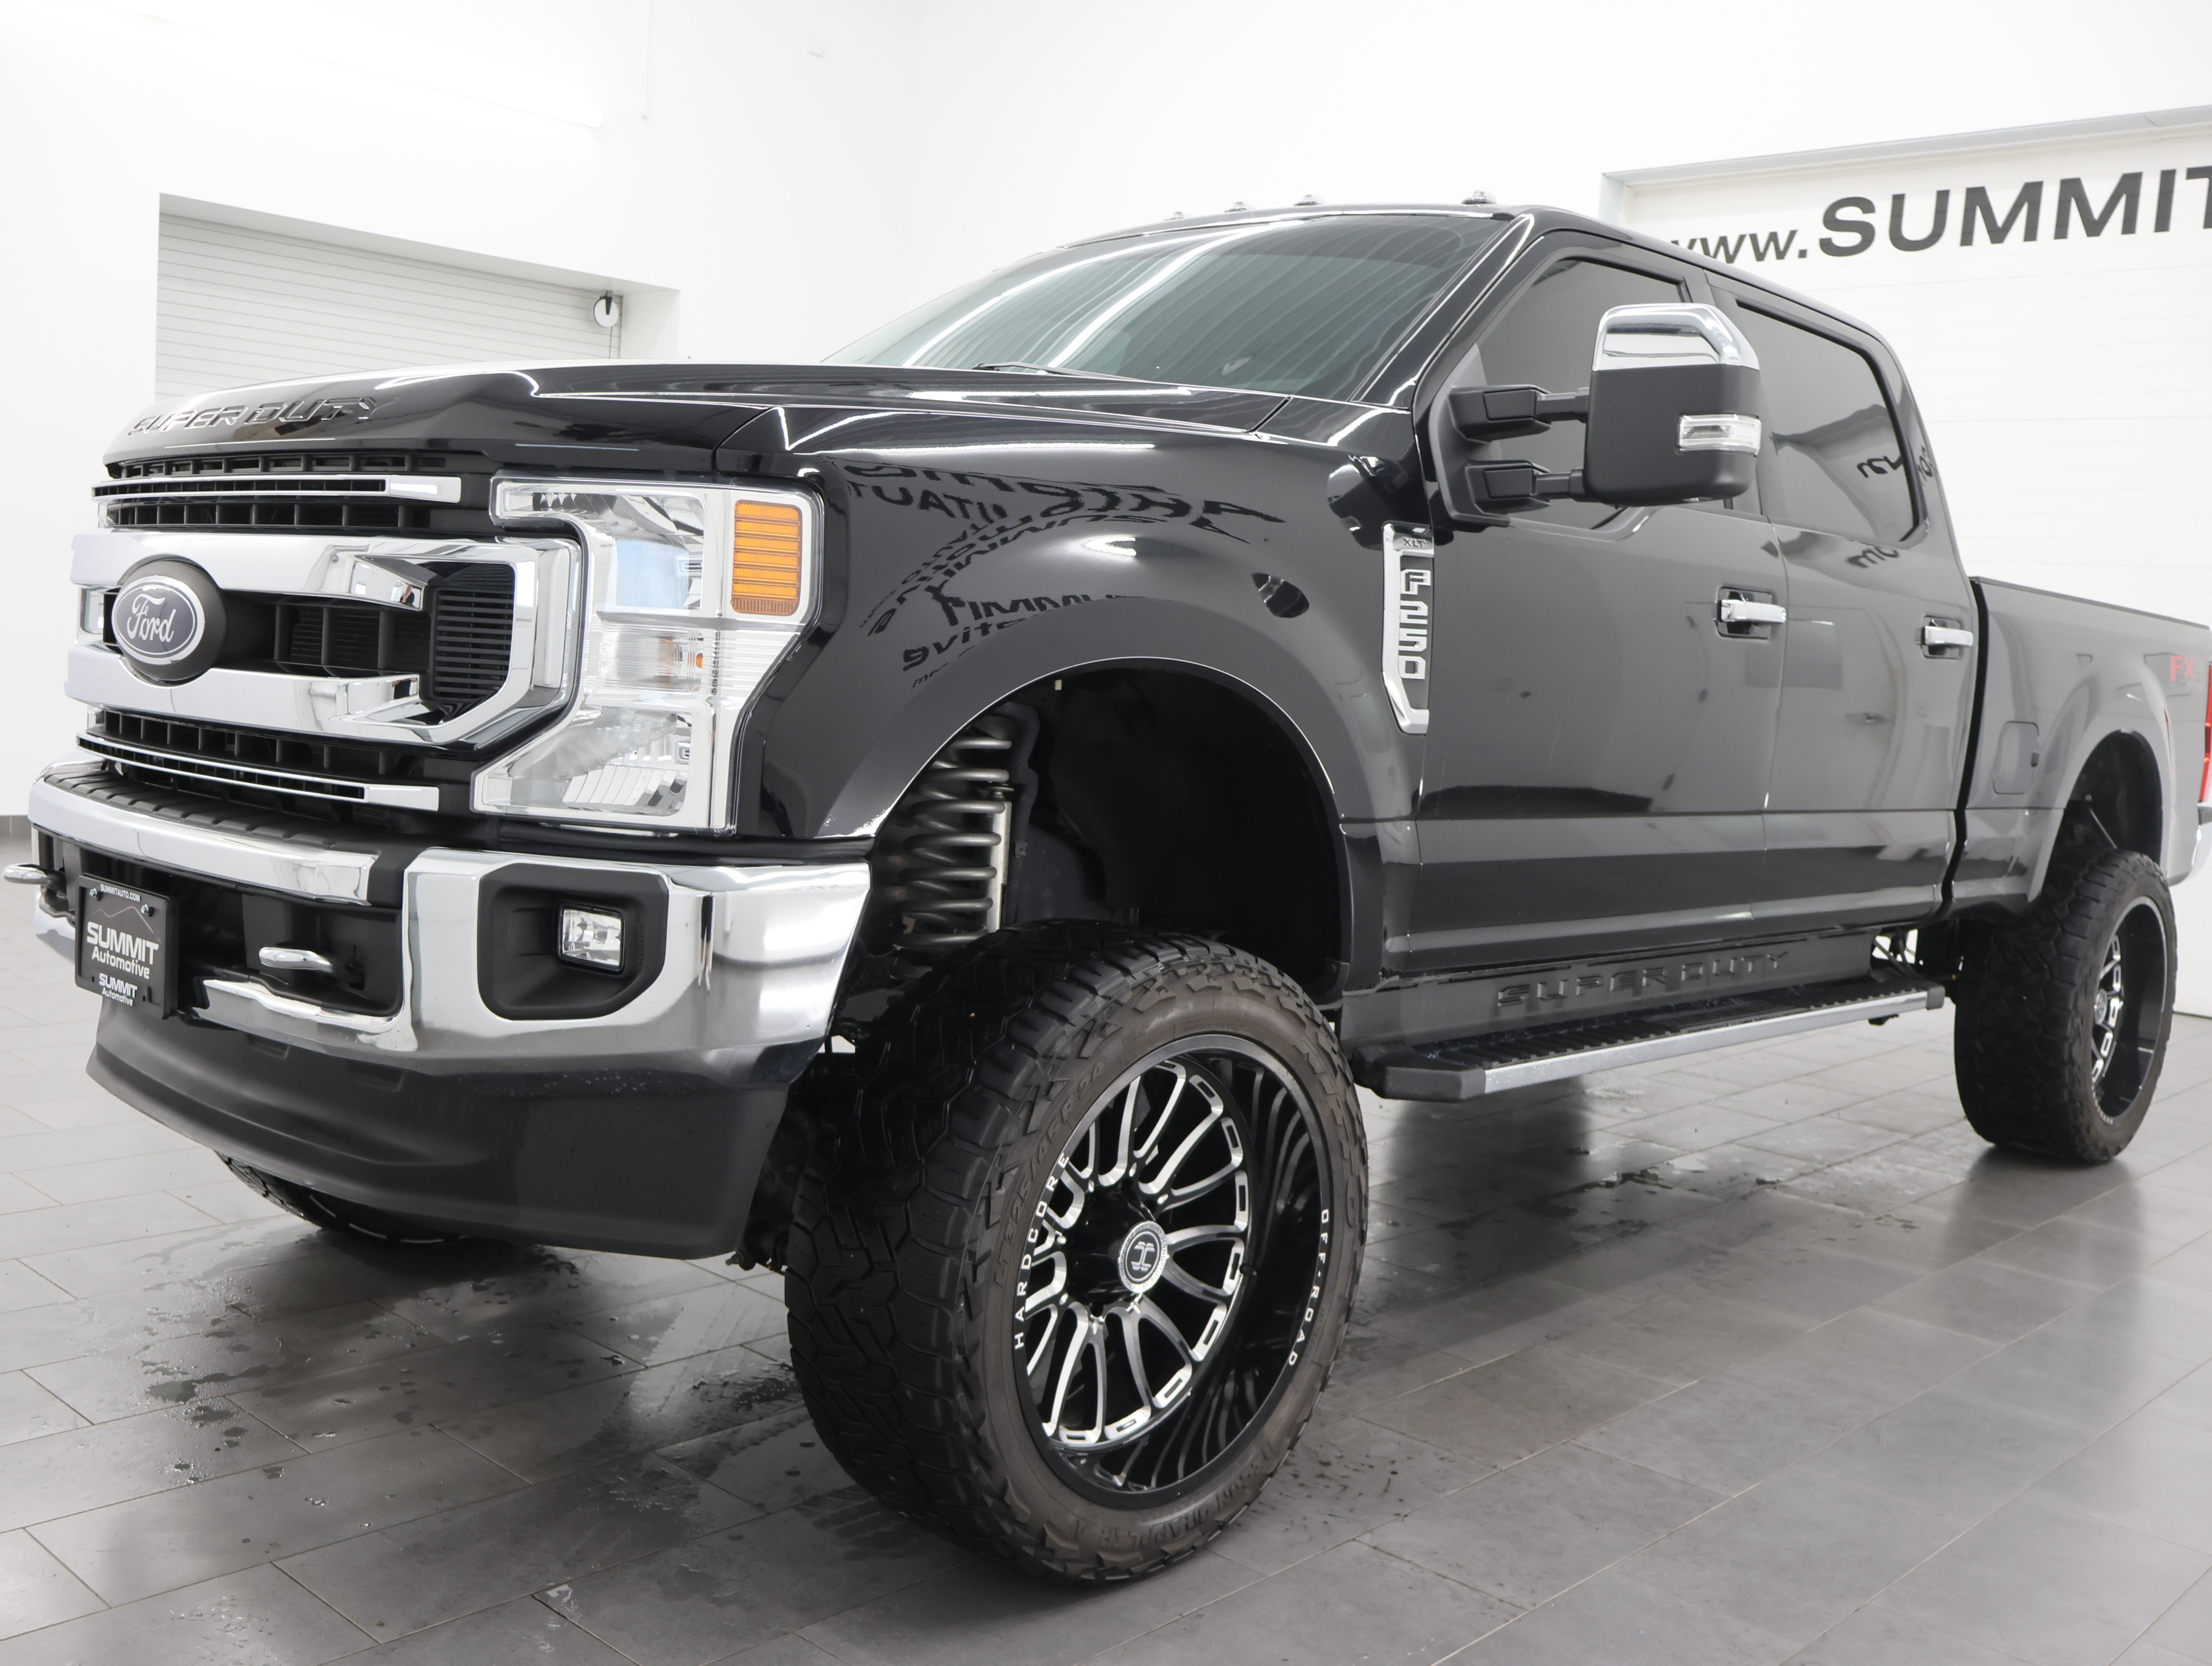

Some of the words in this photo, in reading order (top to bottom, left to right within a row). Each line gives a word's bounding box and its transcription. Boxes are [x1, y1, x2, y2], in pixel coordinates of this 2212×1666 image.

[244, 396, 379, 424] DUTY
[1403, 538, 1426, 548] XLT
[127, 594, 177, 643] Ford
[1398, 569, 1431, 679] F250
[100, 883, 141, 902] SUMMITAUTO.COM
[86, 921, 159, 965] SUMMIT
[91, 946, 150, 980] Automotive
[1497, 966, 1668, 1007] SUPER
[1680, 951, 1788, 981] DUTY
[99, 973, 138, 998] SUMMIT
[102, 987, 133, 1007] Automotive
[1014, 1152, 1070, 1349] HARDCORE
